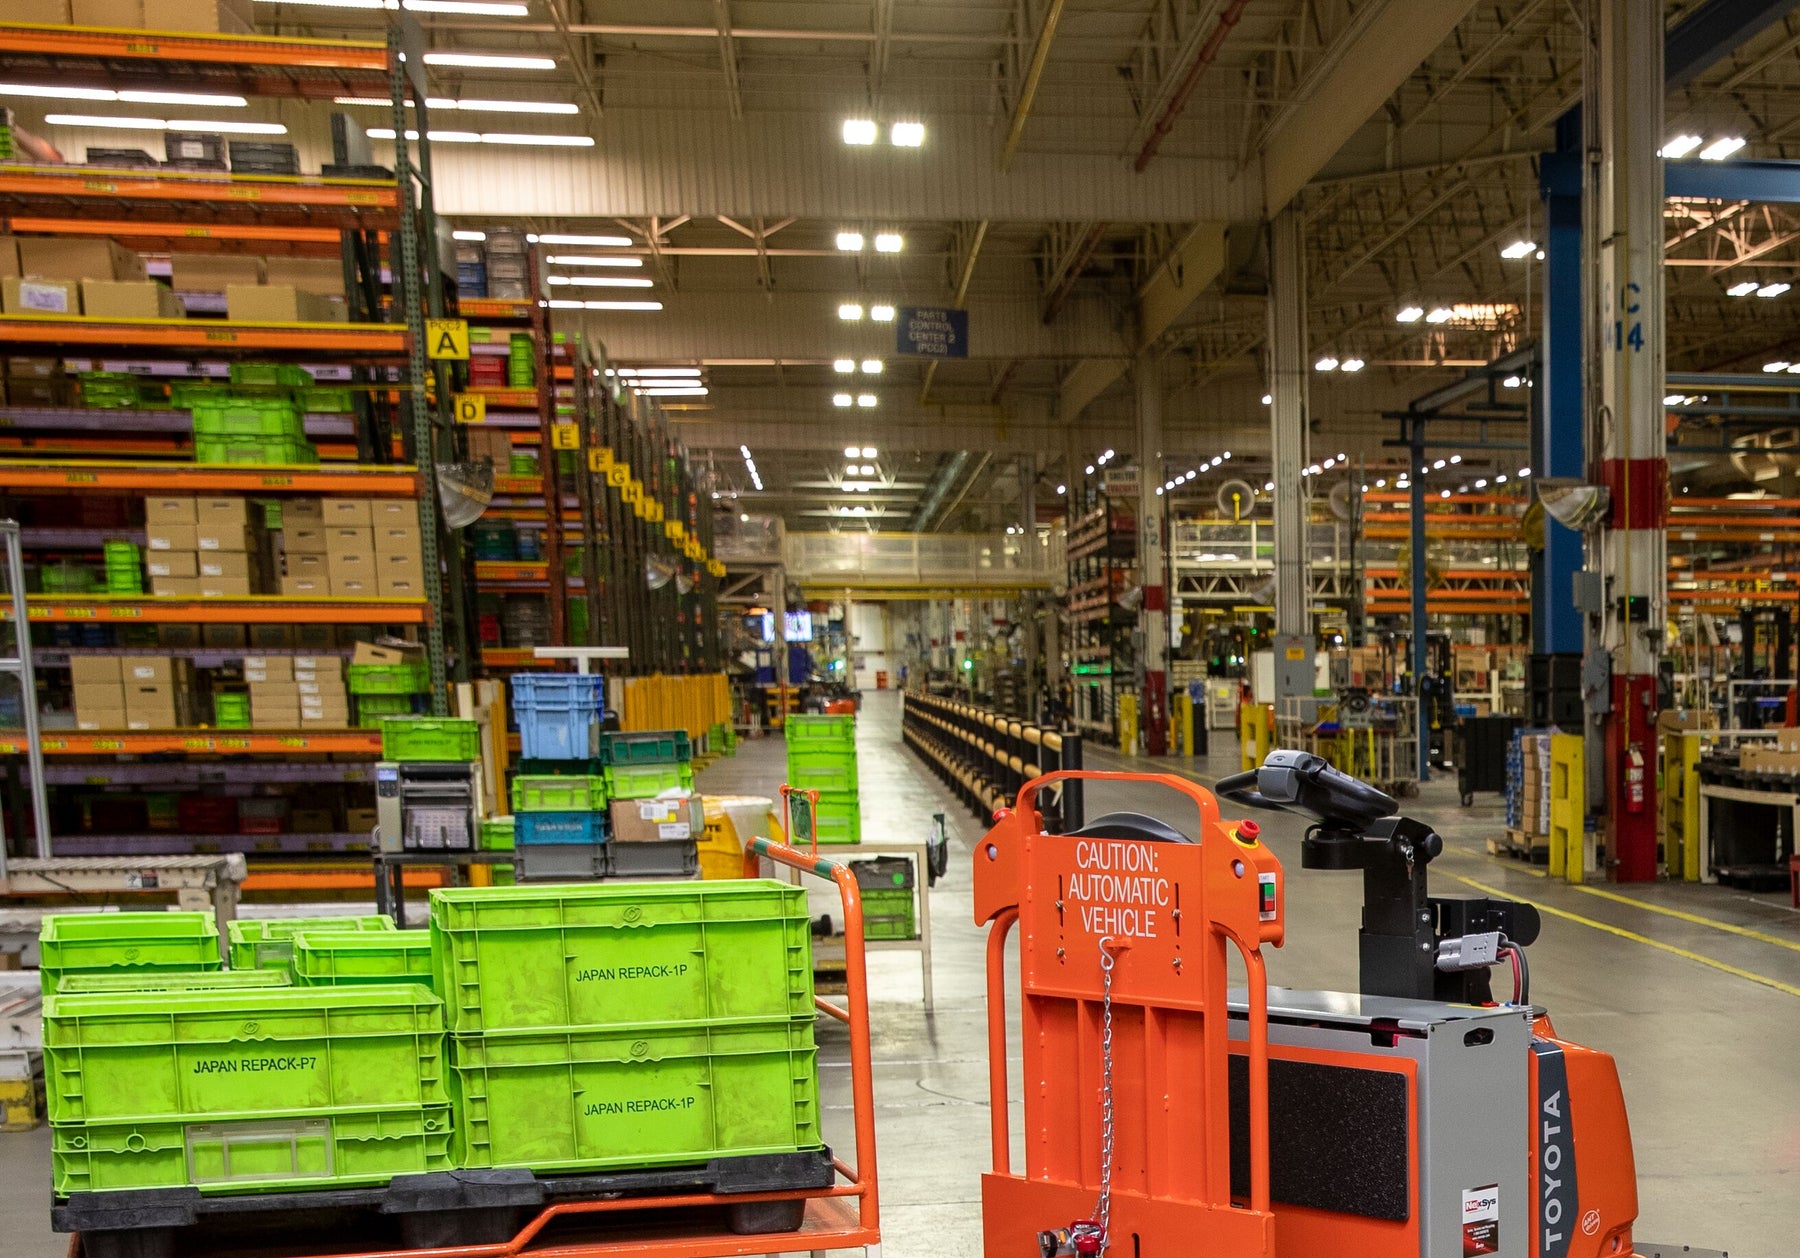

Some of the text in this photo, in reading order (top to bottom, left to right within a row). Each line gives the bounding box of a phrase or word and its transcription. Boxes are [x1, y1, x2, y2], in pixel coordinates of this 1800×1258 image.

[429, 320, 462, 331] PCC2
[437, 332, 458, 354] A
[1615, 321, 1645, 352] 14
[462, 403, 476, 419] D
[560, 430, 572, 447] E
[595, 453, 606, 466] F
[613, 470, 625, 482] G
[1076, 841, 1159, 873] CAUTION:
[1068, 873, 1169, 907] AUTOMATIC
[1080, 905, 1157, 938] VEHICLE
[576, 964, 688, 982] JAPAN REPACK-1P
[193, 1057, 317, 1074] JAPAN REPACK-P7
[584, 1096, 695, 1116] JAPAN REPACK-1P
[1543, 1090, 1562, 1251] TOYOTA
[1465, 1198, 1496, 1211] NexSys
